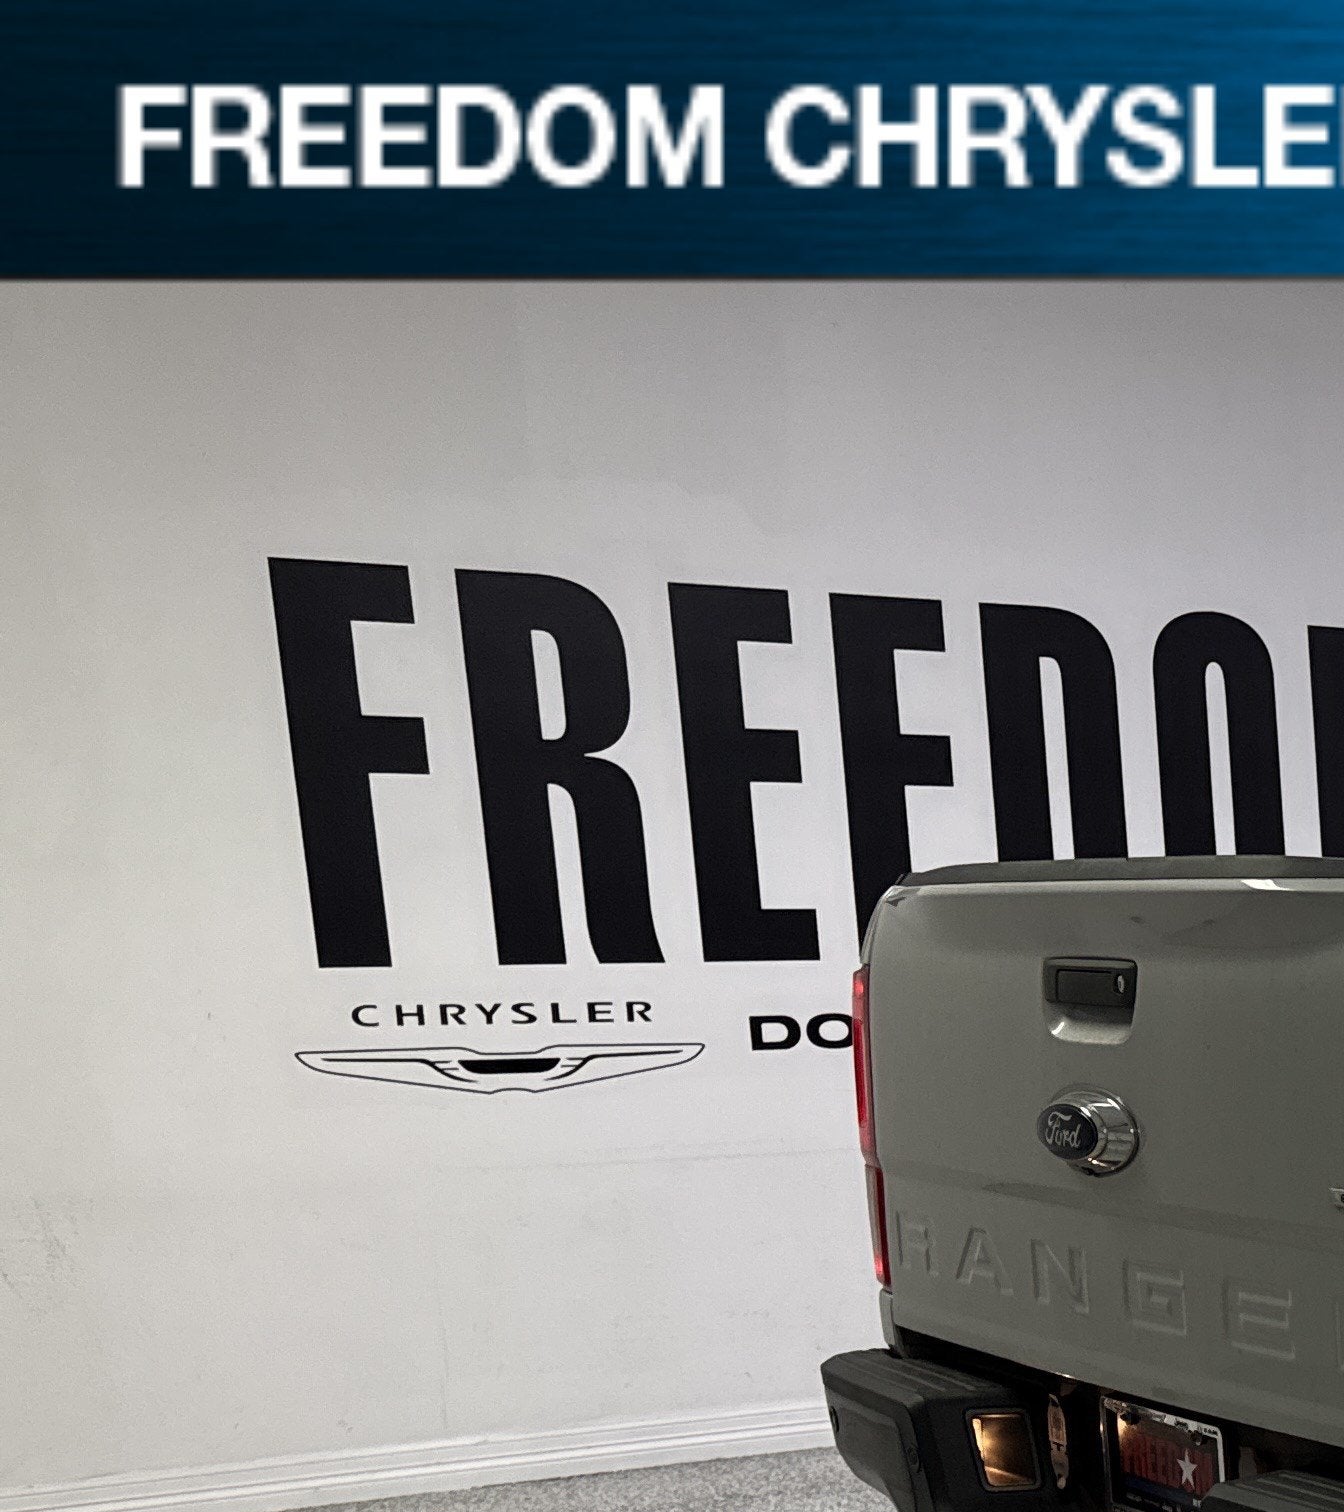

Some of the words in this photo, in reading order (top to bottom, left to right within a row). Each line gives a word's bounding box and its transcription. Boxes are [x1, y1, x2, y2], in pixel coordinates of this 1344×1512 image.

[350, 1001, 654, 1027] CHRYSLER
[748, 1012, 855, 1051] DO
[1044, 1110, 1082, 1150] Ford
